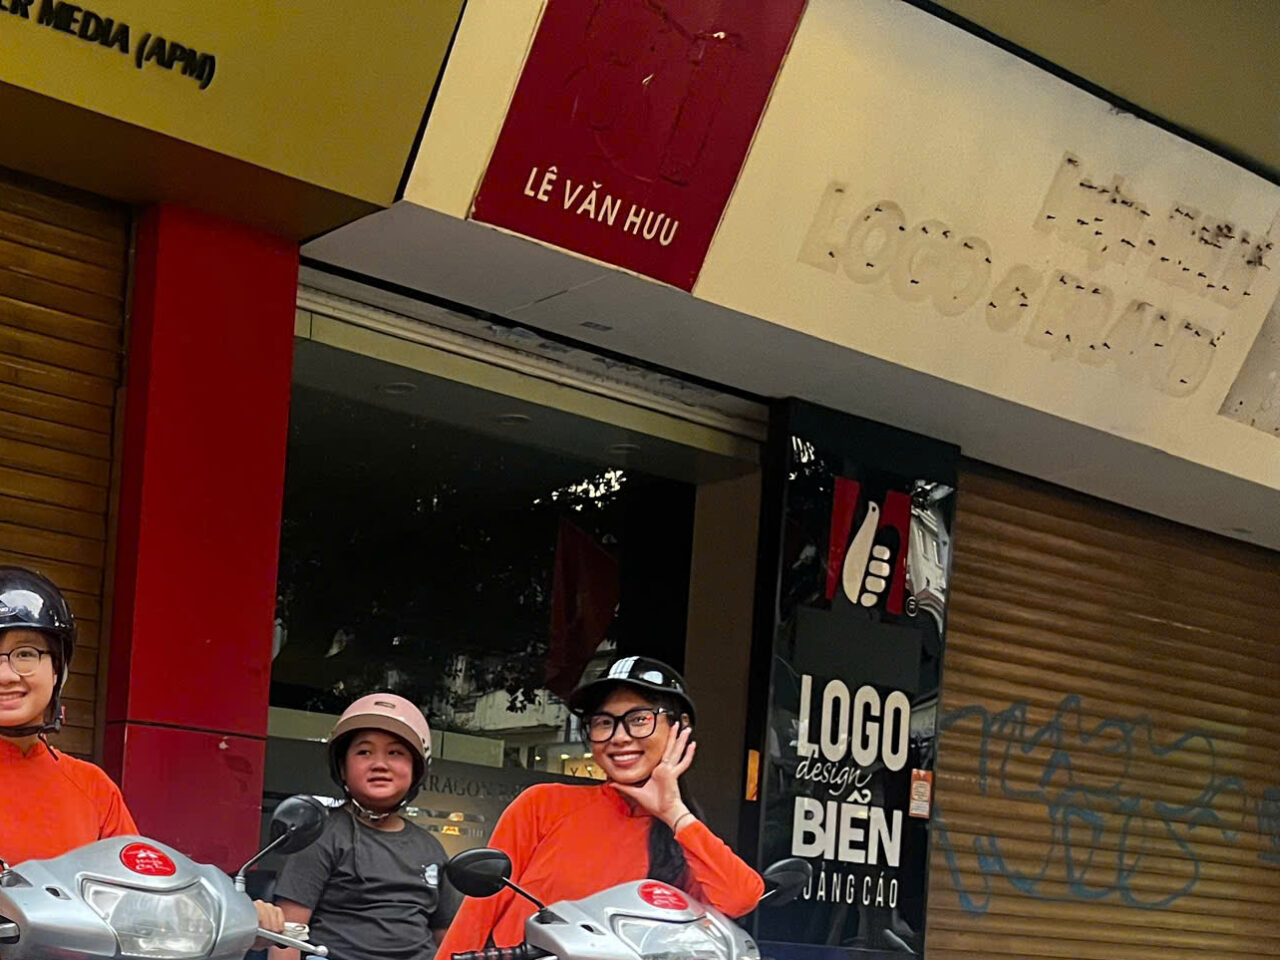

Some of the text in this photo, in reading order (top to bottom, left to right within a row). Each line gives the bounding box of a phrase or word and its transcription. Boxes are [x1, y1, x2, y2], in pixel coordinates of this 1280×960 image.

[37, 1, 130, 54] MEDIA
[135, 32, 216, 91] (APM)
[523, 165, 558, 202] LÊ
[563, 179, 622, 226] VĂN
[797, 674, 911, 772] LOGO
[795, 752, 872, 796] design
[791, 789, 903, 868] BIỂN
[862, 871, 898, 909] CÁO
